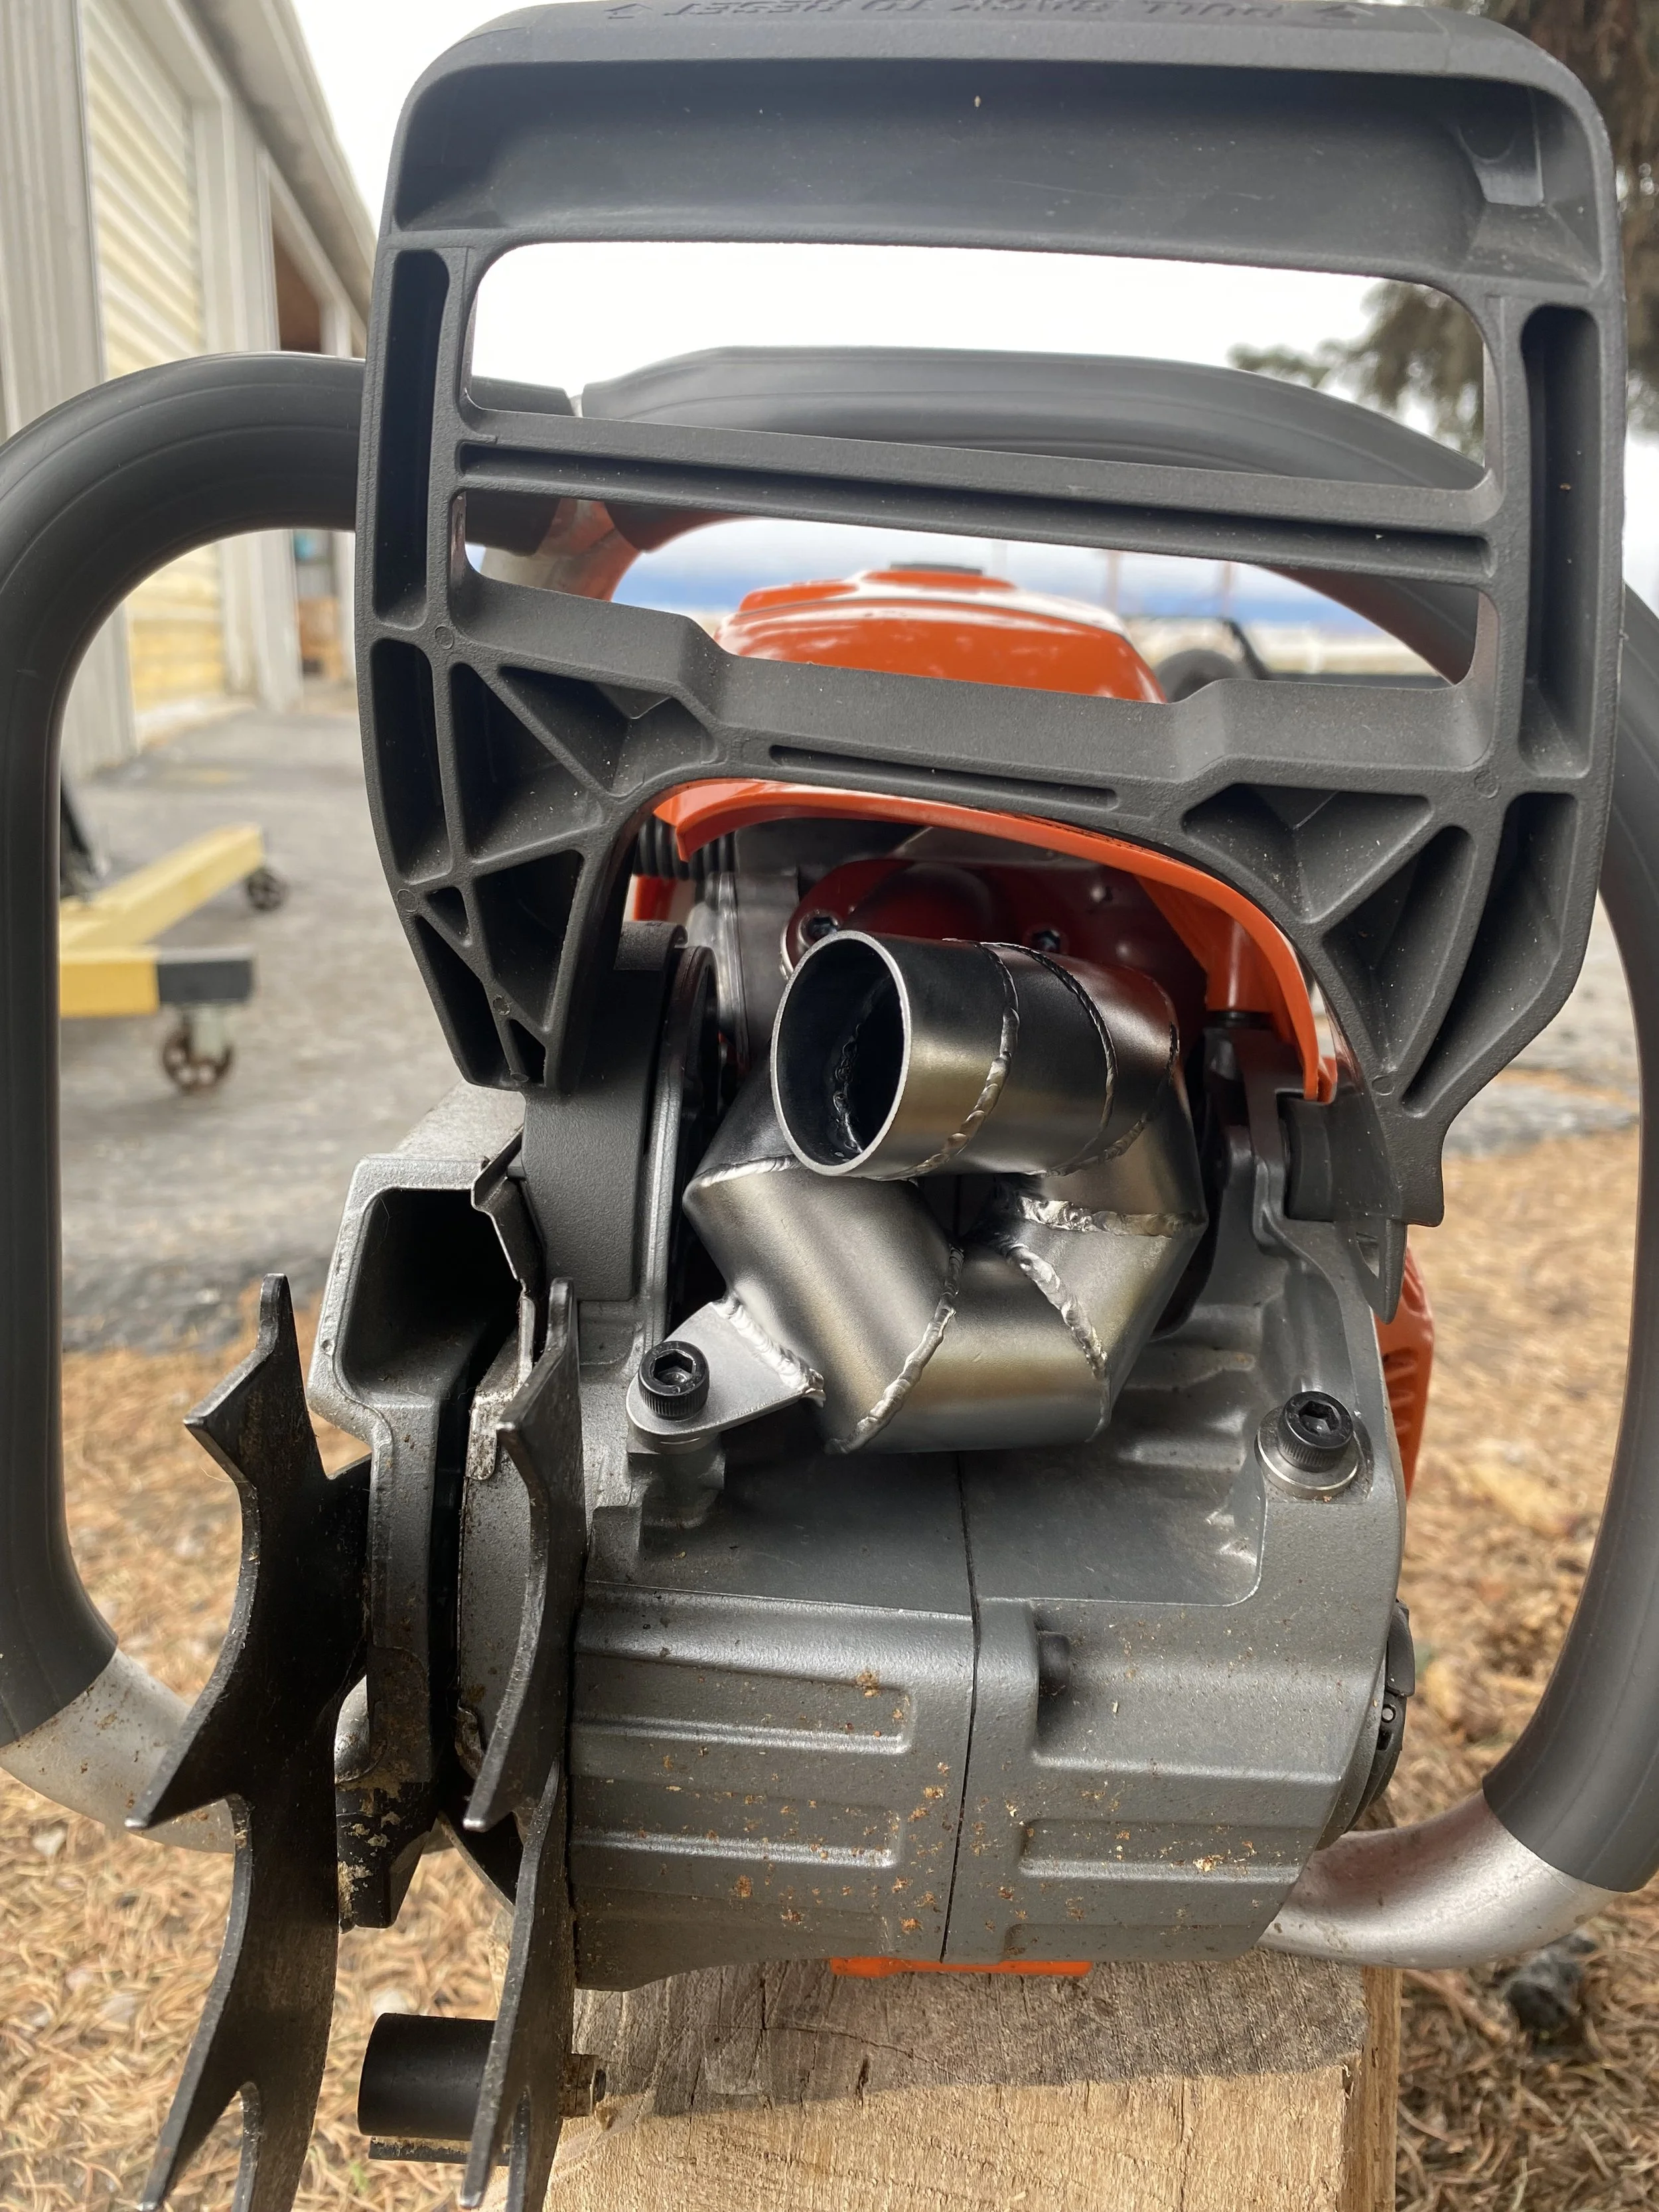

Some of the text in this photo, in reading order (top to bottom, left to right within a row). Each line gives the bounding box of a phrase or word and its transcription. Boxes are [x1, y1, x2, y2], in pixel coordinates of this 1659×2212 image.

[662, 0, 851, 16] RESET
[860, 0, 933, 11] TO
[1142, 1, 1283, 18] PULL
